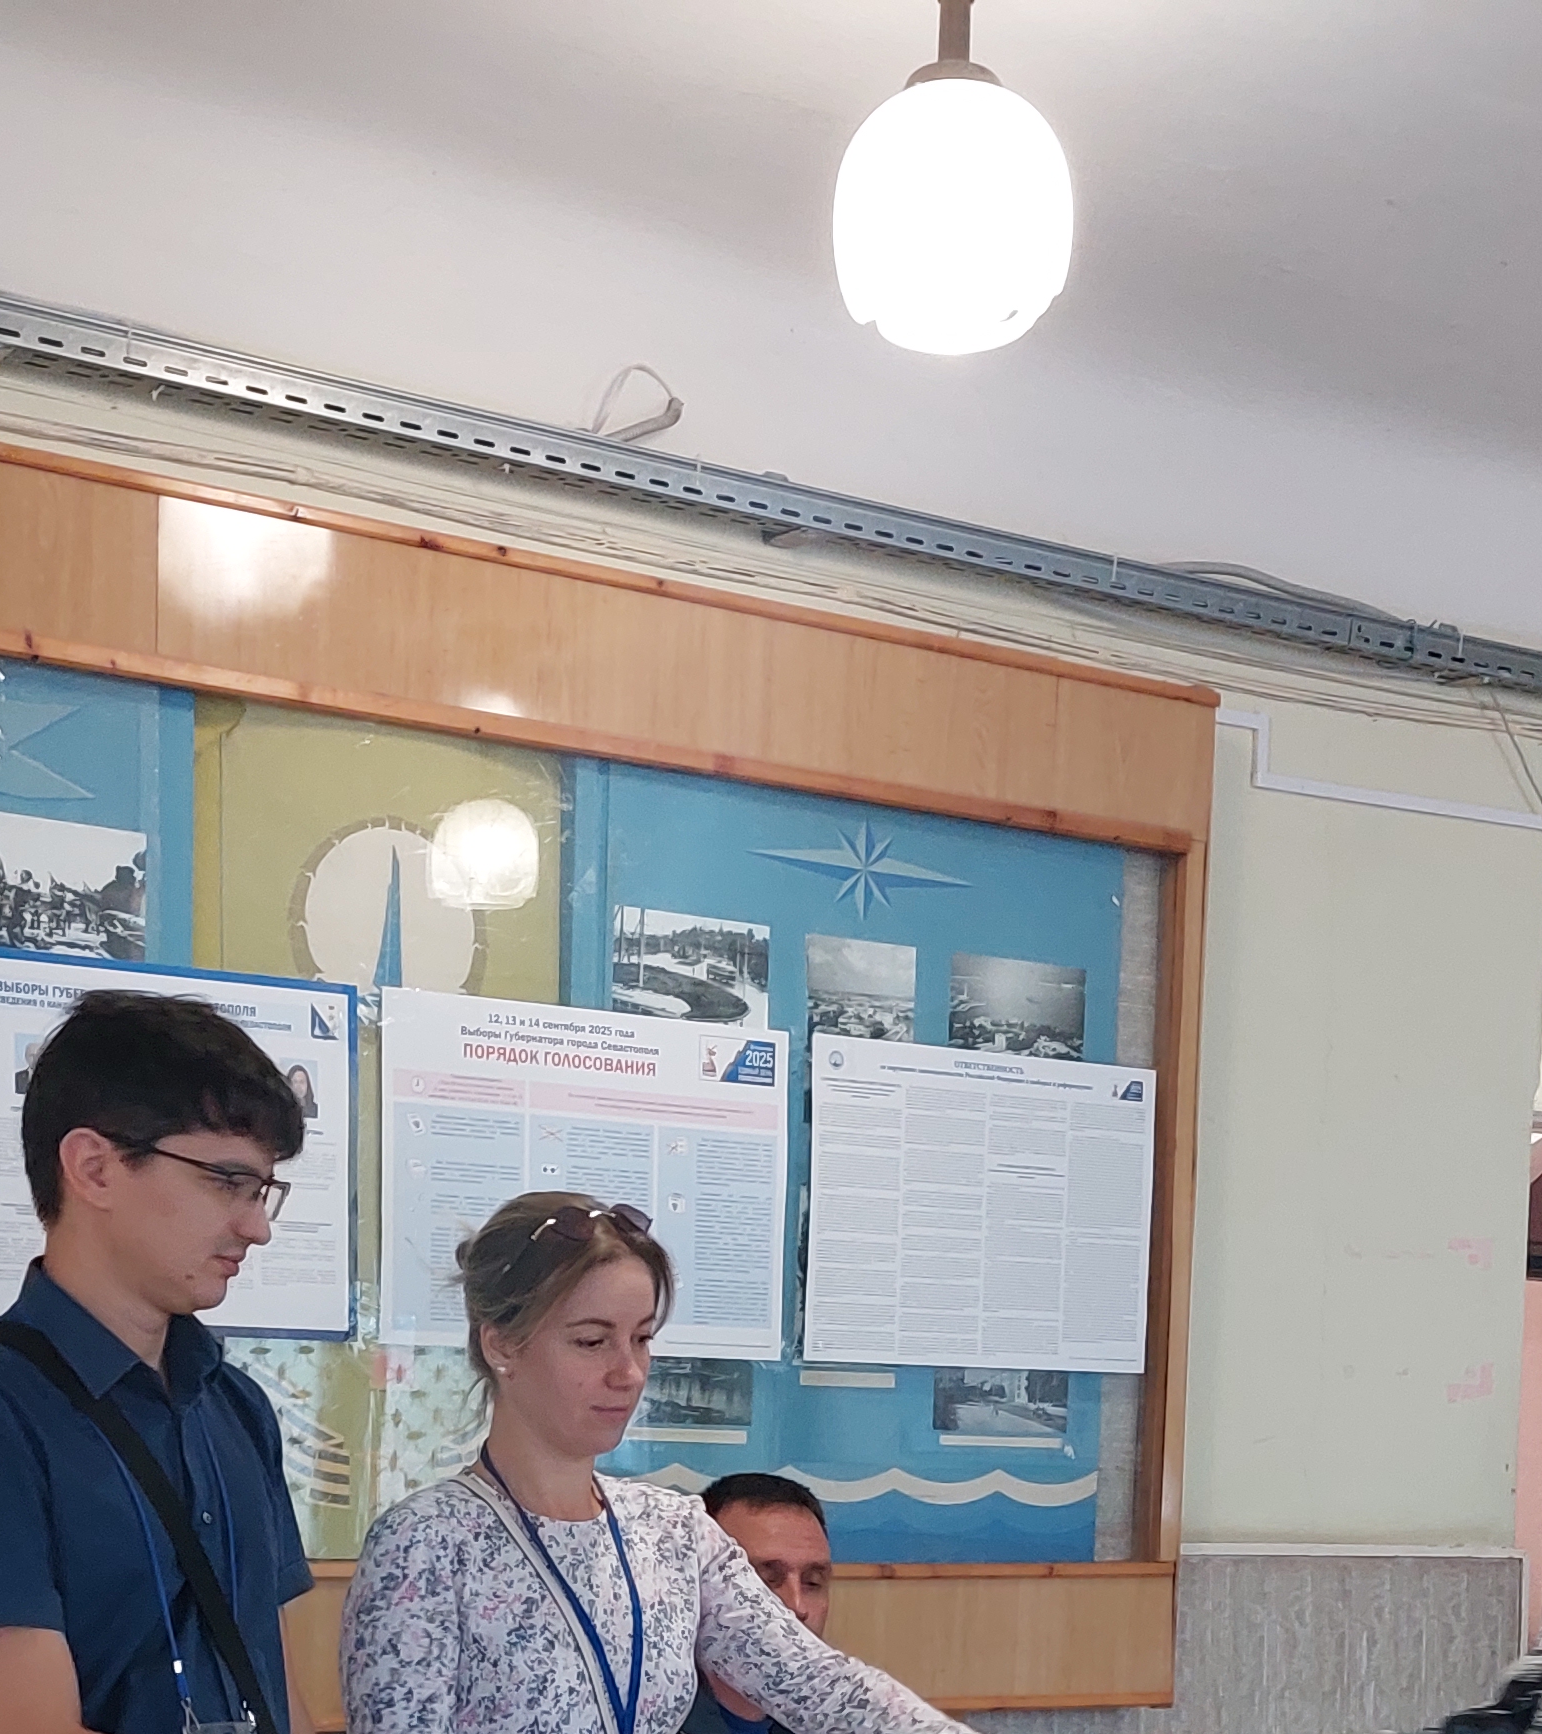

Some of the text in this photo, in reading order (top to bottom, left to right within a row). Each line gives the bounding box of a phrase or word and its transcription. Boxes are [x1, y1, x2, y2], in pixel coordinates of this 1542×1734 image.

[488, 1013, 635, 1039] 12, 13 и 14 сентября 2025 года
[460, 1025, 660, 1056] Выборы Губернатора города Севастополя
[463, 1042, 657, 1077] ПОРЯДОК ГОЛОСОВАНИЯ
[745, 1049, 774, 1068] 2025
